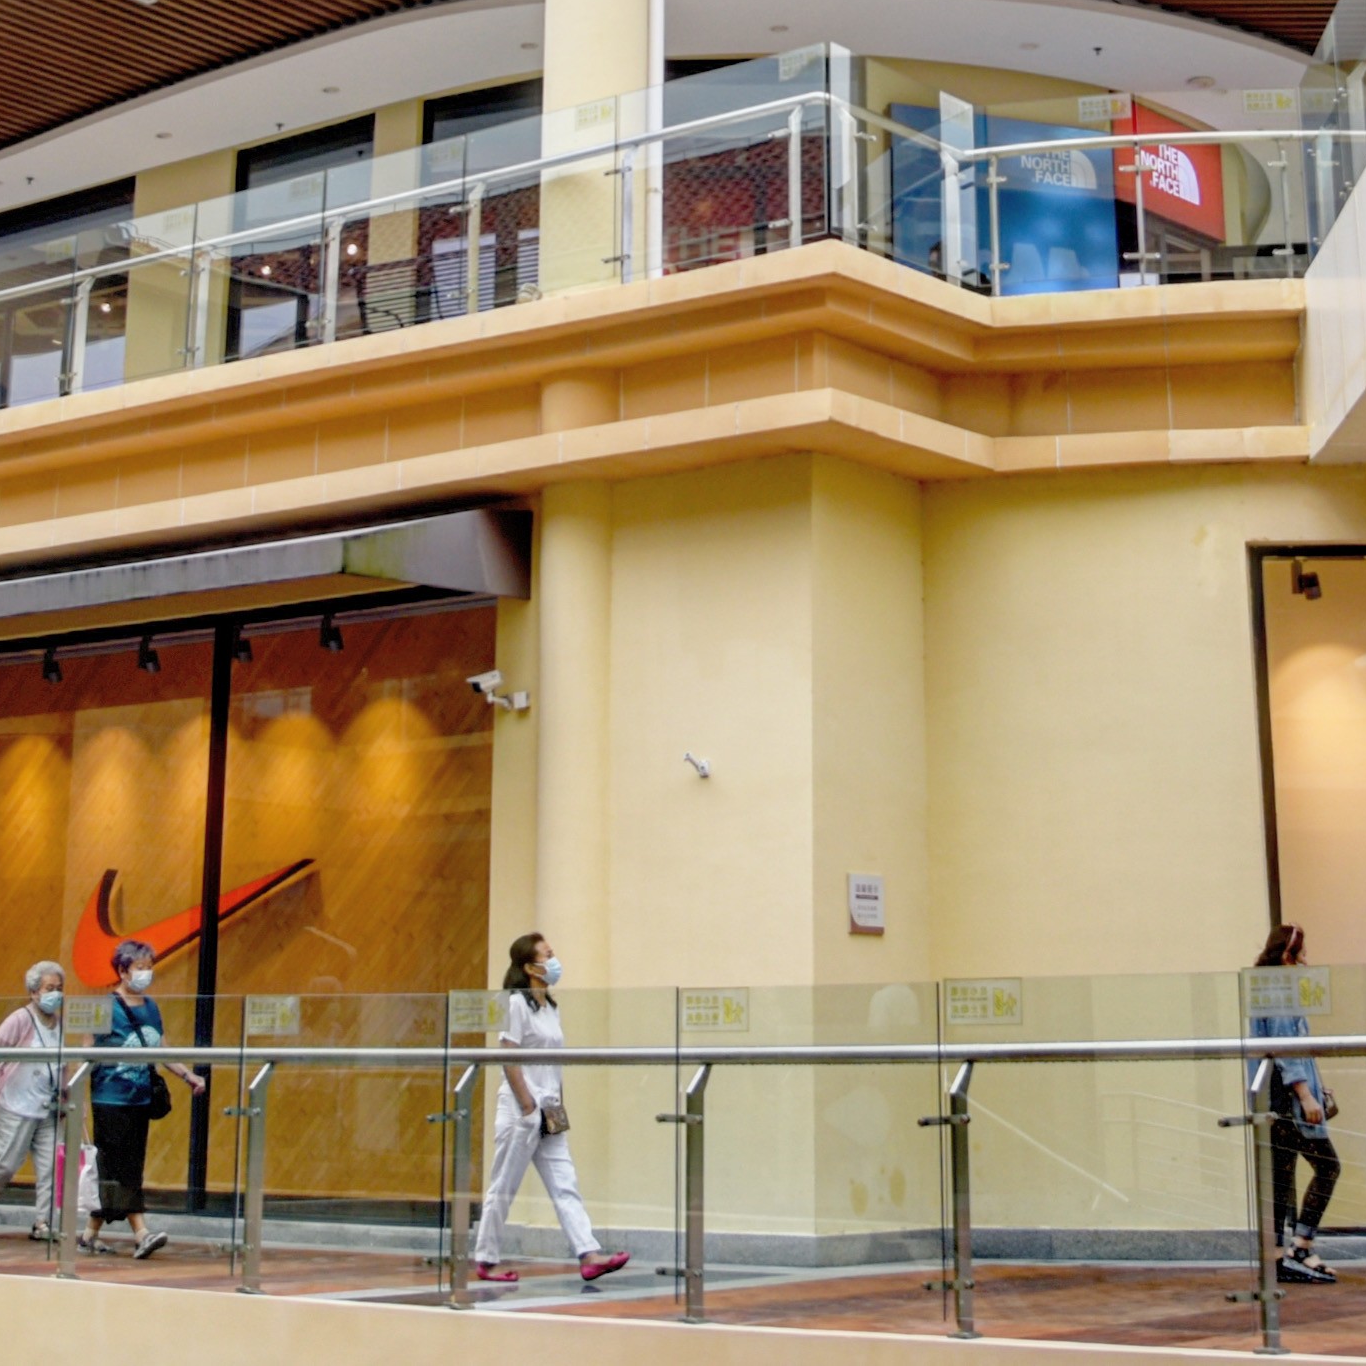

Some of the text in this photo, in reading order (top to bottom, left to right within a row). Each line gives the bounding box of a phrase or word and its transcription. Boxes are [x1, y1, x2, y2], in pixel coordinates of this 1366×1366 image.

[1020, 154, 1070, 175] NORTH
[1140, 148, 1179, 181] NORTH
[1034, 170, 1070, 187] FACE
[1151, 171, 1180, 198] FACE
